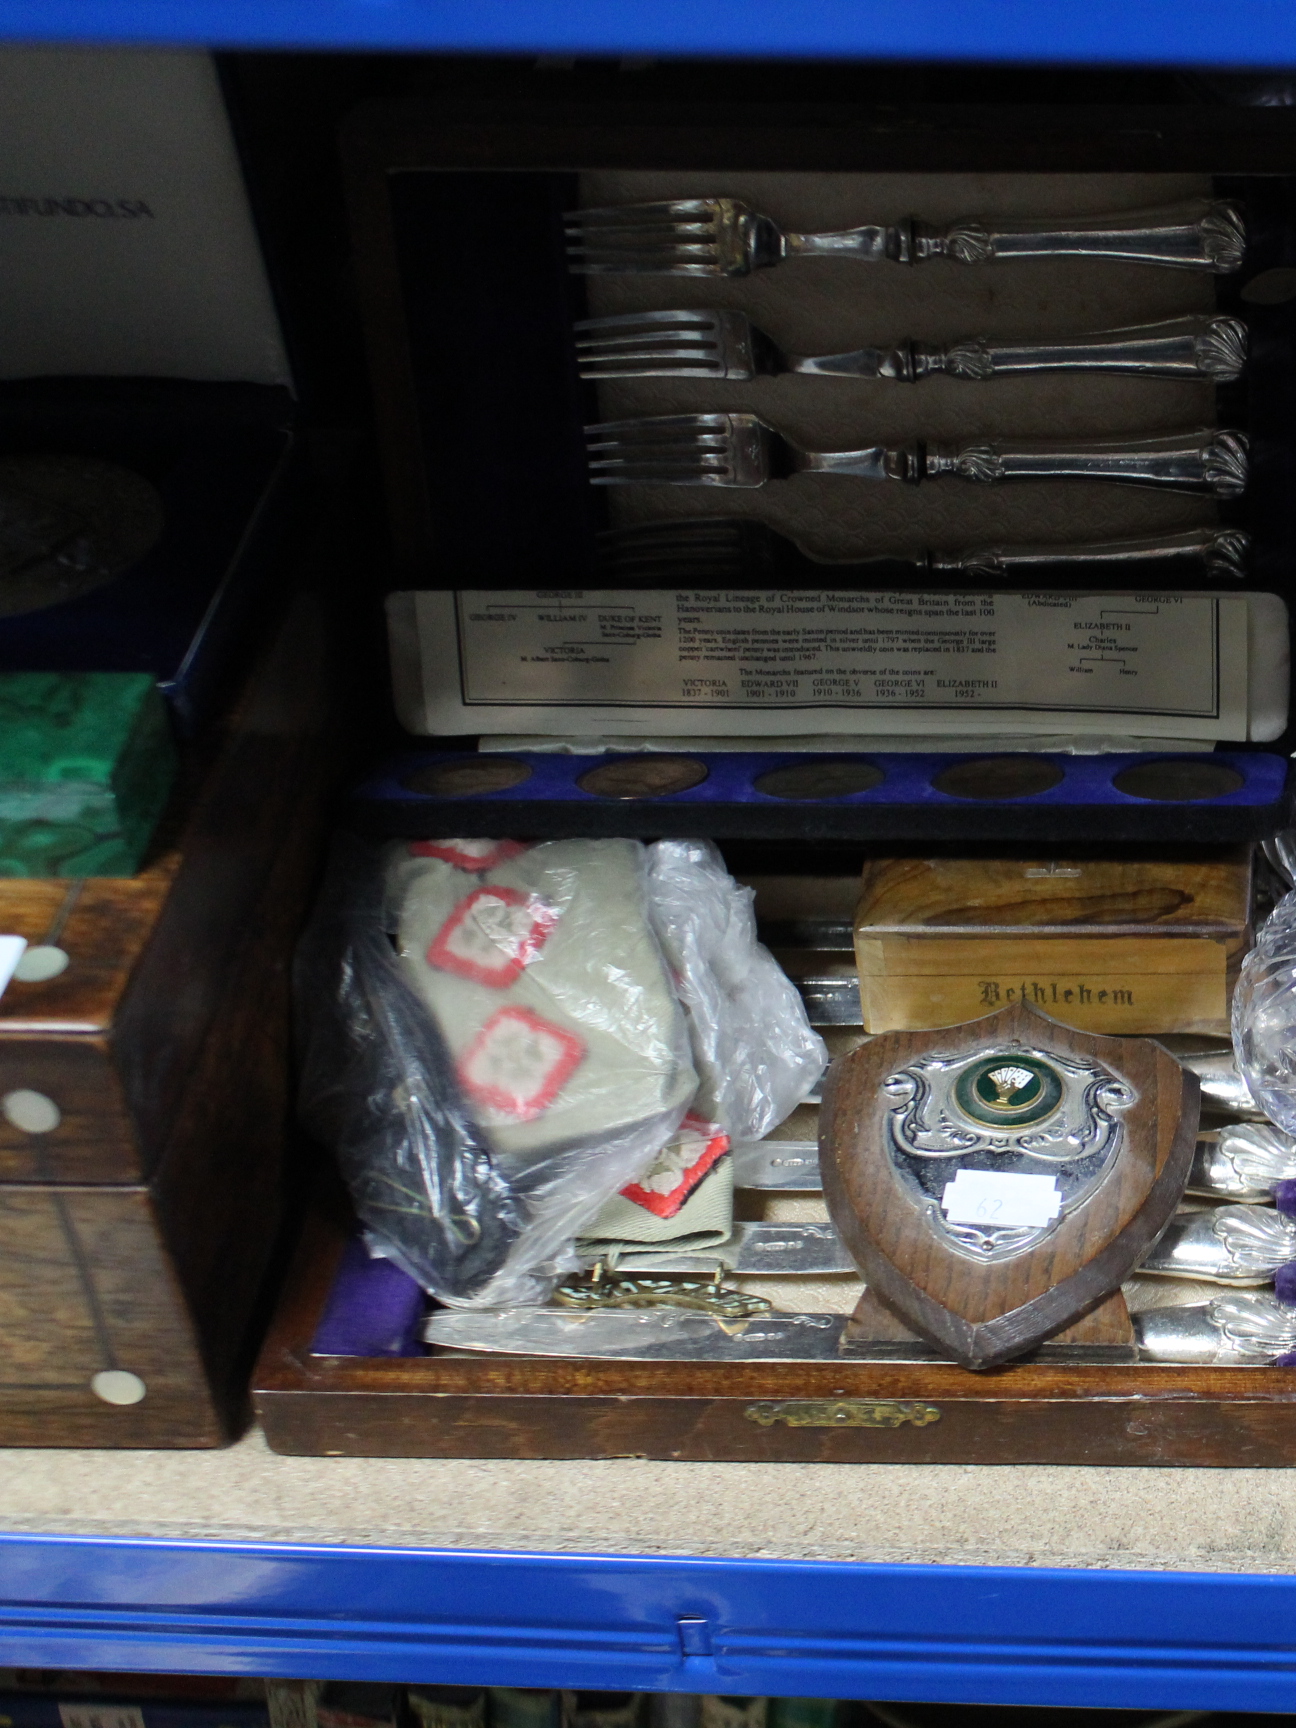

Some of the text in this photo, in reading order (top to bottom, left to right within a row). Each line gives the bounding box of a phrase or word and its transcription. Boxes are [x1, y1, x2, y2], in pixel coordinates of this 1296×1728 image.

[676, 594, 690, 602] the
[694, 594, 721, 605] Royal
[725, 594, 761, 605] Lineage
[765, 594, 775, 602] of
[779, 594, 821, 603] Crowned
[825, 594, 870, 604] Monarchs
[874, 595, 885, 604] of
[888, 595, 914, 605] Great
[918, 597, 949, 606] Britain
[953, 597, 976, 606] from
[980, 597, 994, 606] the
[676, 604, 995, 618] Hanoverians to the Royal House of Windsor whose reigns span the last 100
[537, 613, 588, 622] WILLIAM IV
[597, 614, 662, 623] DUKE OF KENT
[677, 616, 702, 626] years.
[1073, 622, 1131, 631] ELIZABETH II
[678, 636, 696, 644] 1200
[698, 637, 719, 645] years.
[721, 637, 749, 646] English
[751, 637, 779, 646] pennies
[801, 636, 828, 644] minted
[881, 636, 899, 644] 1797
[923, 637, 935, 645] the
[937, 637, 965, 647] George
[978, 638, 996, 646] large
[1088, 635, 1117, 644] Charles
[543, 646, 586, 655] VICTORIA
[678, 653, 818, 664] penny remained unchanged until 1967.
[754, 668, 792, 676] Monarchs
[793, 667, 824, 676] featured
[848, 667, 877, 675] obverse
[878, 667, 888, 675] of
[1068, 665, 1094, 674] William
[1118, 667, 1138, 676] Henry
[682, 678, 728, 688] VICTORIA
[740, 679, 799, 688] EDWARD VII
[812, 678, 860, 688] GEORGE V
[873, 679, 925, 688] GEORGE VI
[936, 680, 998, 688] ELIZABETH II
[681, 688, 702, 697] 1837
[710, 688, 730, 697] 1901
[745, 689, 765, 698] 1901
[774, 689, 796, 698] 1910
[812, 688, 833, 697] 1910
[841, 688, 862, 697] 1936
[875, 688, 896, 697] 1936
[904, 688, 925, 698] 1952
[954, 688, 975, 698] 1952
[978, 980, 1135, 1007] Bethlehem
[976, 1197, 1003, 1220] 62
